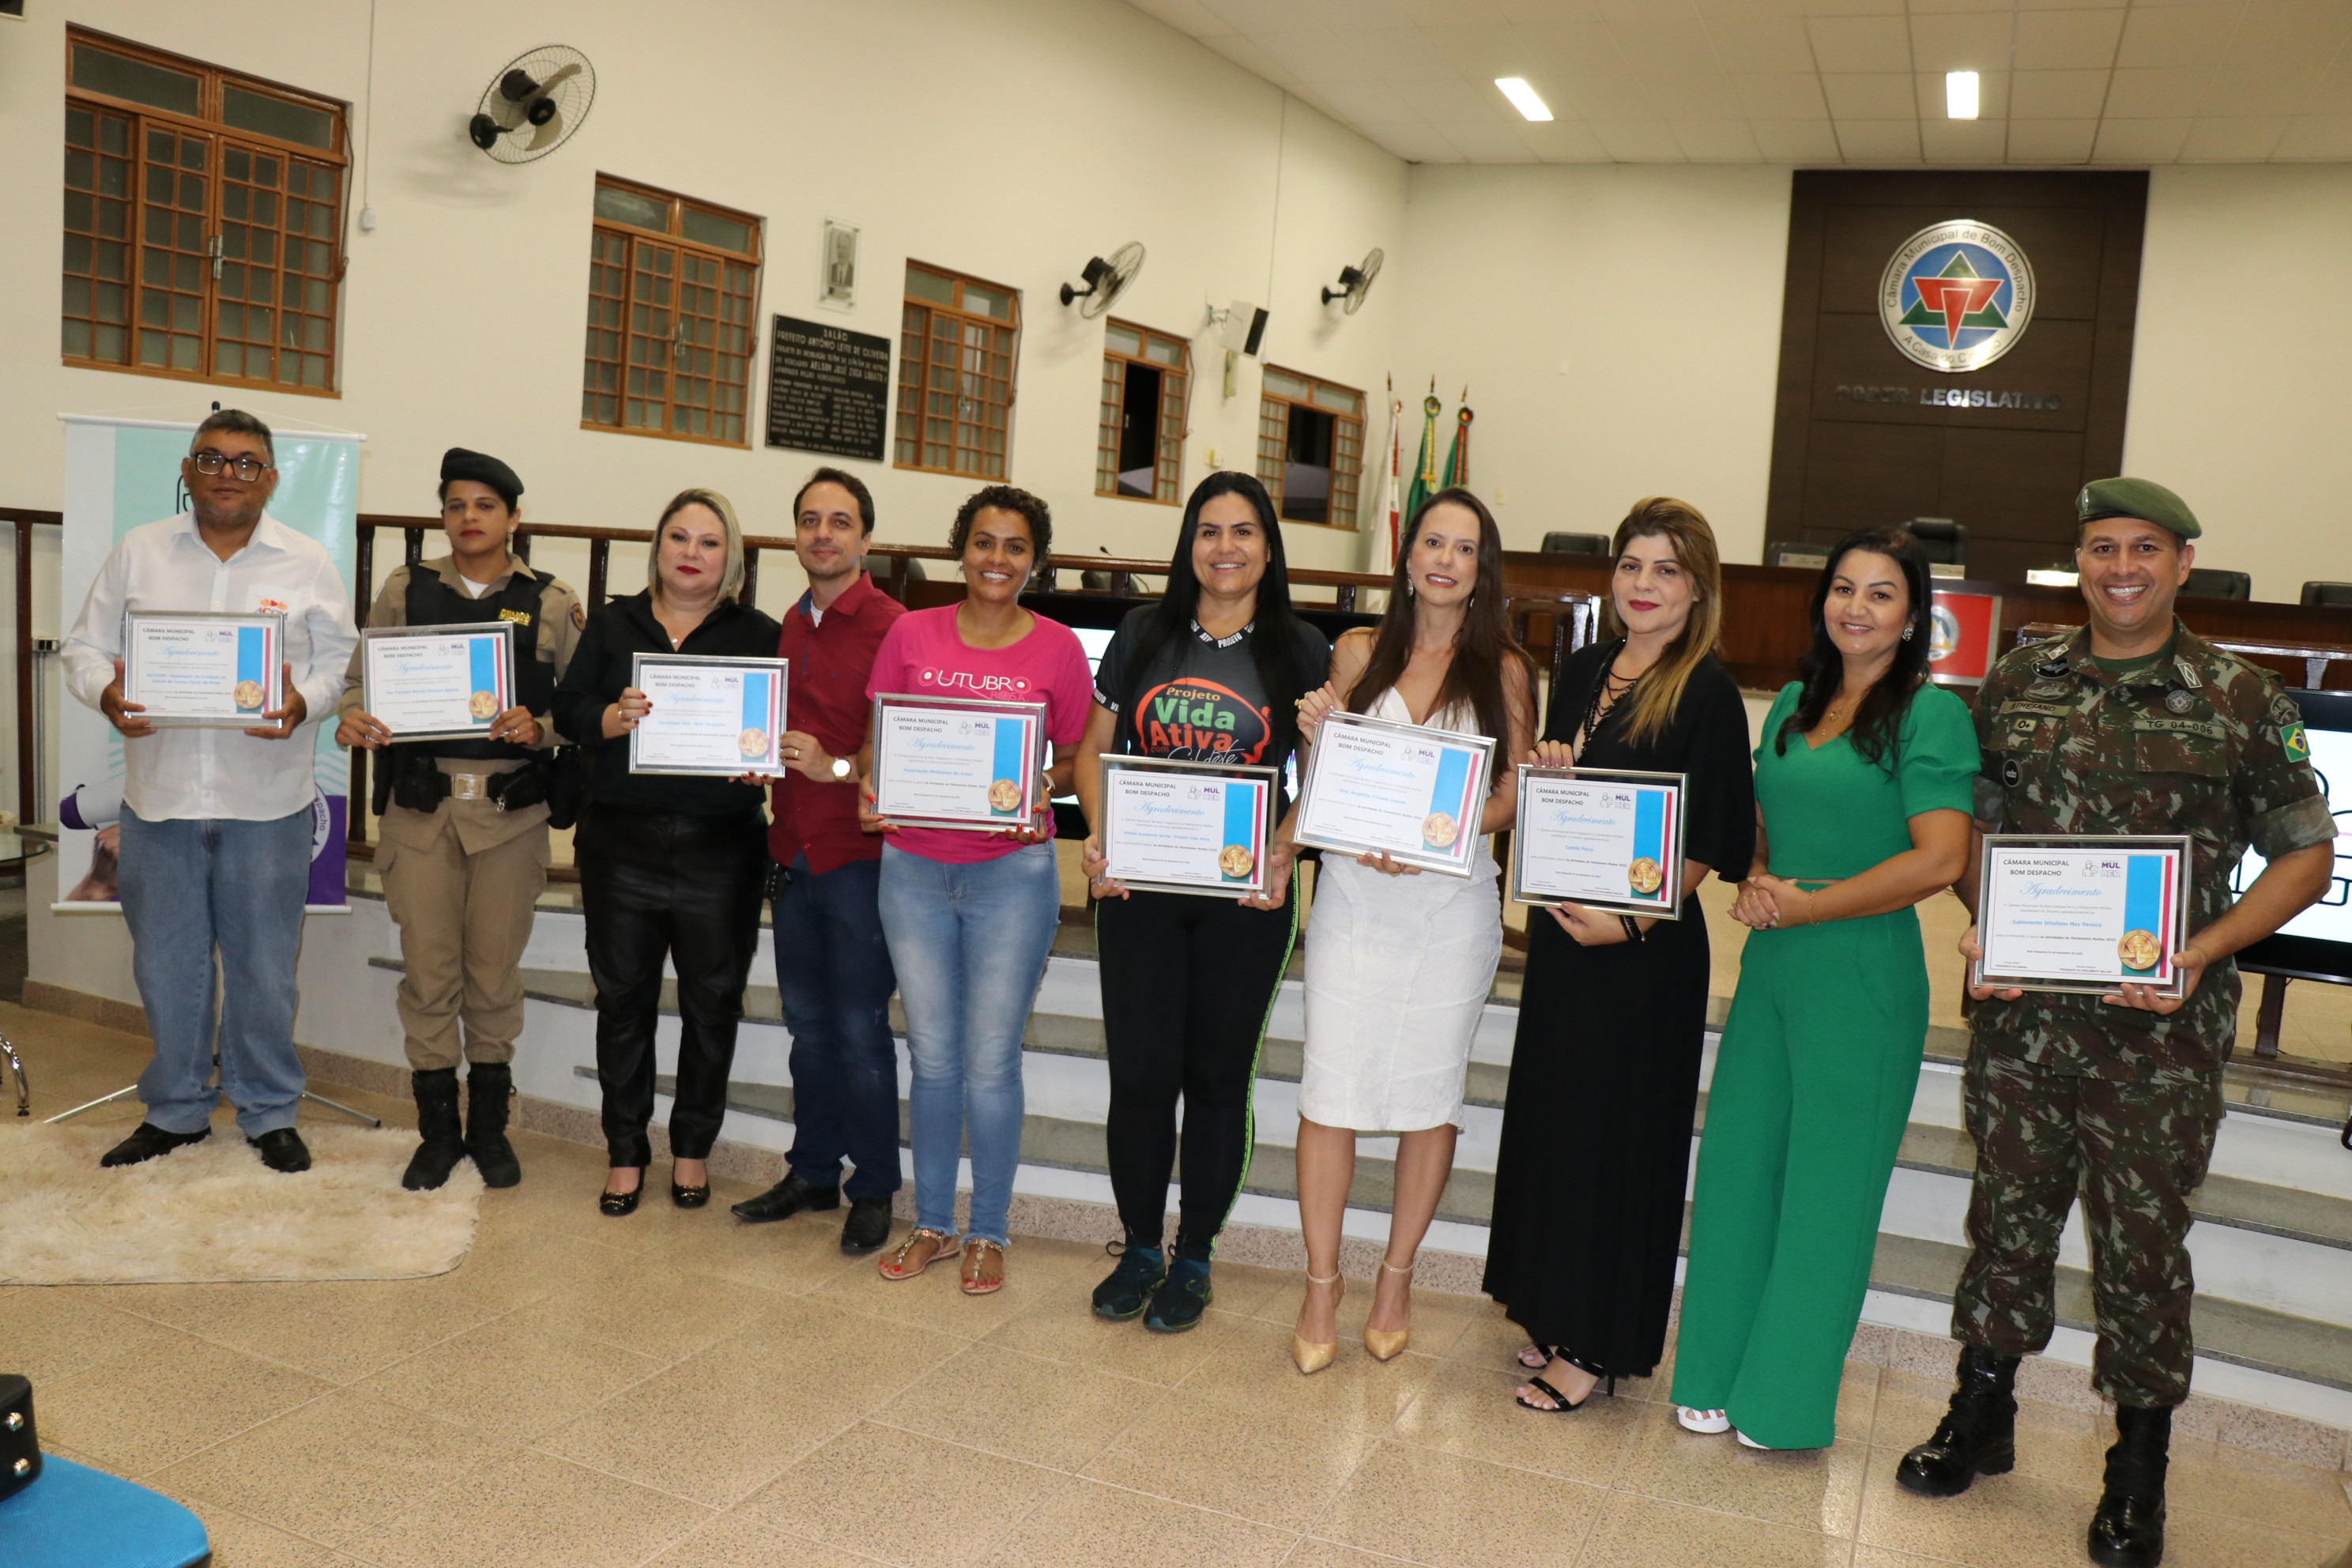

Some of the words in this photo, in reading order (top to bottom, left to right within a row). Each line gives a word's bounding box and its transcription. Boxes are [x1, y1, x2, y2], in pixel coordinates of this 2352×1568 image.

[1887, 262, 1908, 308] Câmara
[1905, 229, 1958, 261] Municipal
[1962, 229, 1977, 240] de
[1980, 232, 2006, 254] Bom
[2004, 252, 2027, 312] Despacho
[776, 330, 806, 345] PREFEITO
[824, 329, 847, 341] SALÃO
[1903, 335, 1913, 345] A
[1911, 341, 1936, 360] Casa
[1920, 388, 2062, 409] LEGISLATIVO
[1218, 632, 1242, 648] PROJETO
[918, 666, 1031, 694] OUTUBRO
[991, 691, 1026, 702] ROSA
[1166, 687, 1221, 702] Projeto
[1155, 697, 1236, 730] Vida
[2011, 702, 2056, 712] STHEFANO
[2147, 720, 2163, 729] TG
[2170, 721, 2213, 735] 04-006
[907, 737, 975, 751] Agradecimento
[1150, 721, 1233, 751] Ativa
[1334, 733, 1359, 742] CÂMARA
[1359, 737, 1391, 748] MUNICIPAL
[1353, 745, 1384, 756] DESPACHO
[1418, 749, 1434, 758] MUL
[1344, 755, 1416, 778] Agradecimento
[315, 796, 326, 831] spacho
[1134, 800, 1204, 816] Agradecimento
[1549, 809, 1615, 825] Agradecimento
[2019, 880, 2102, 899] Agradecimento
